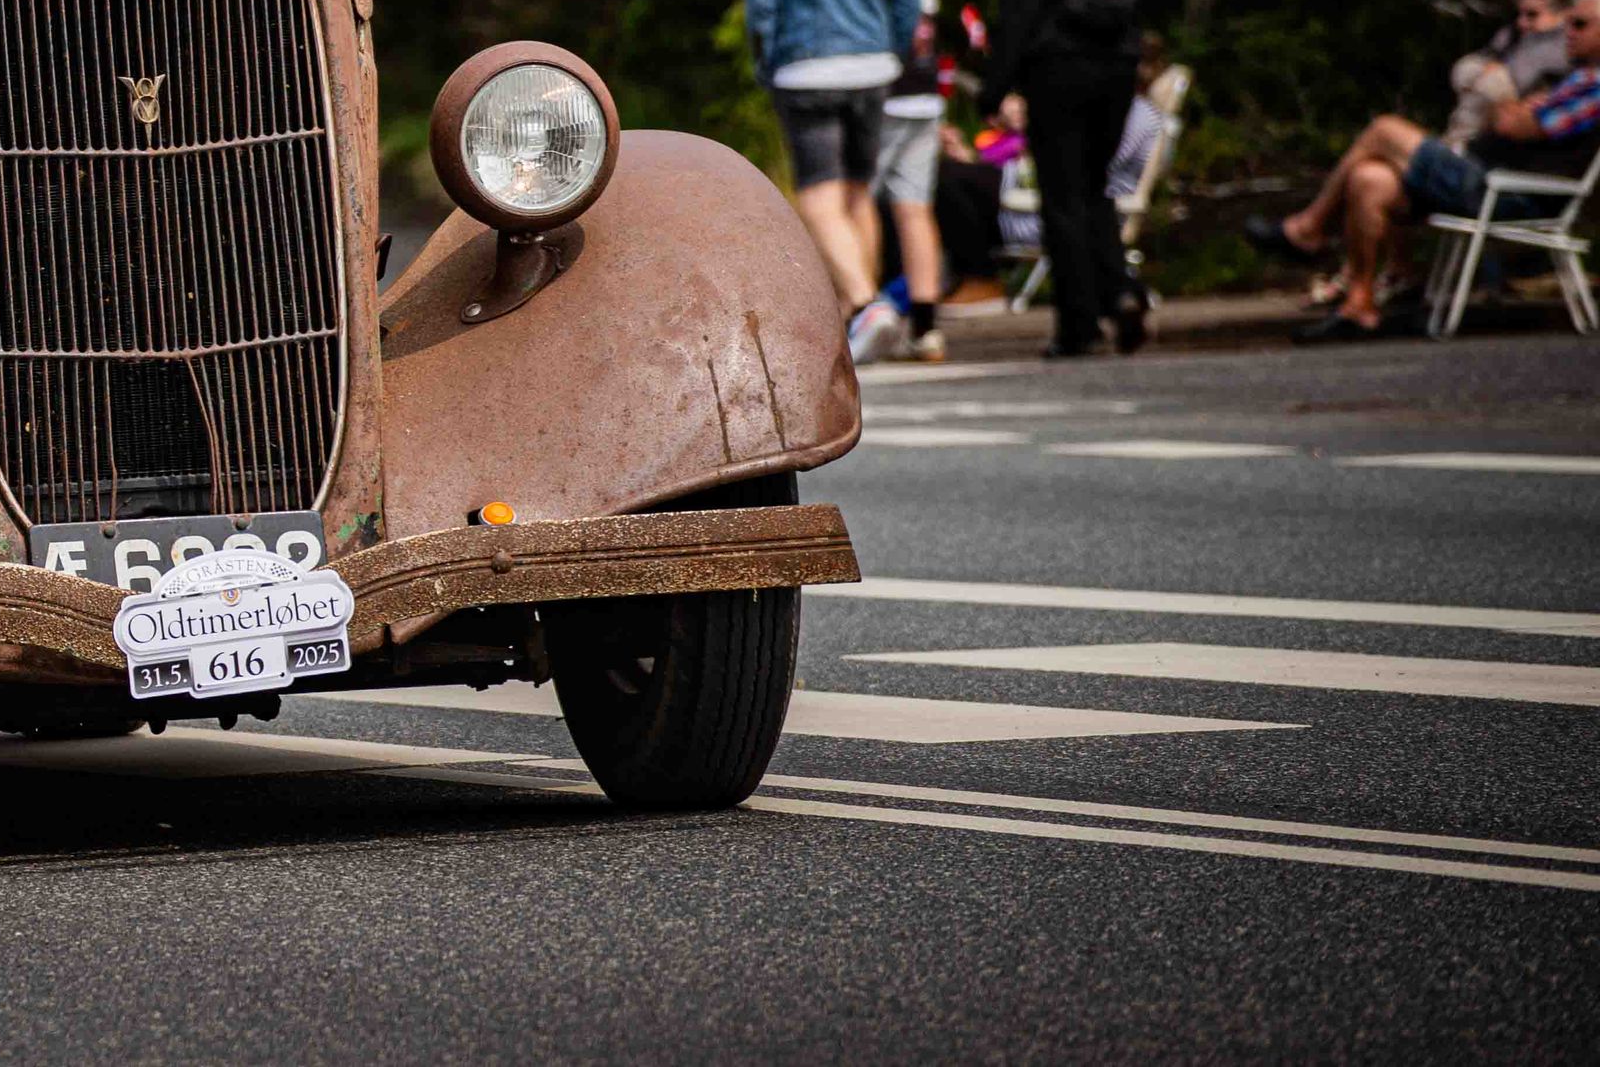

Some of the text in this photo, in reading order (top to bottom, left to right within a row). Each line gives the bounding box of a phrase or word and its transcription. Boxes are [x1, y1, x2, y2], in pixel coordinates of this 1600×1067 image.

[186, 556, 267, 583] GRÅSTEN
[127, 592, 342, 645] Oldtimerløbet
[208, 646, 265, 682] 616
[293, 642, 340, 668] 2025
[140, 664, 188, 689] 31.5.
